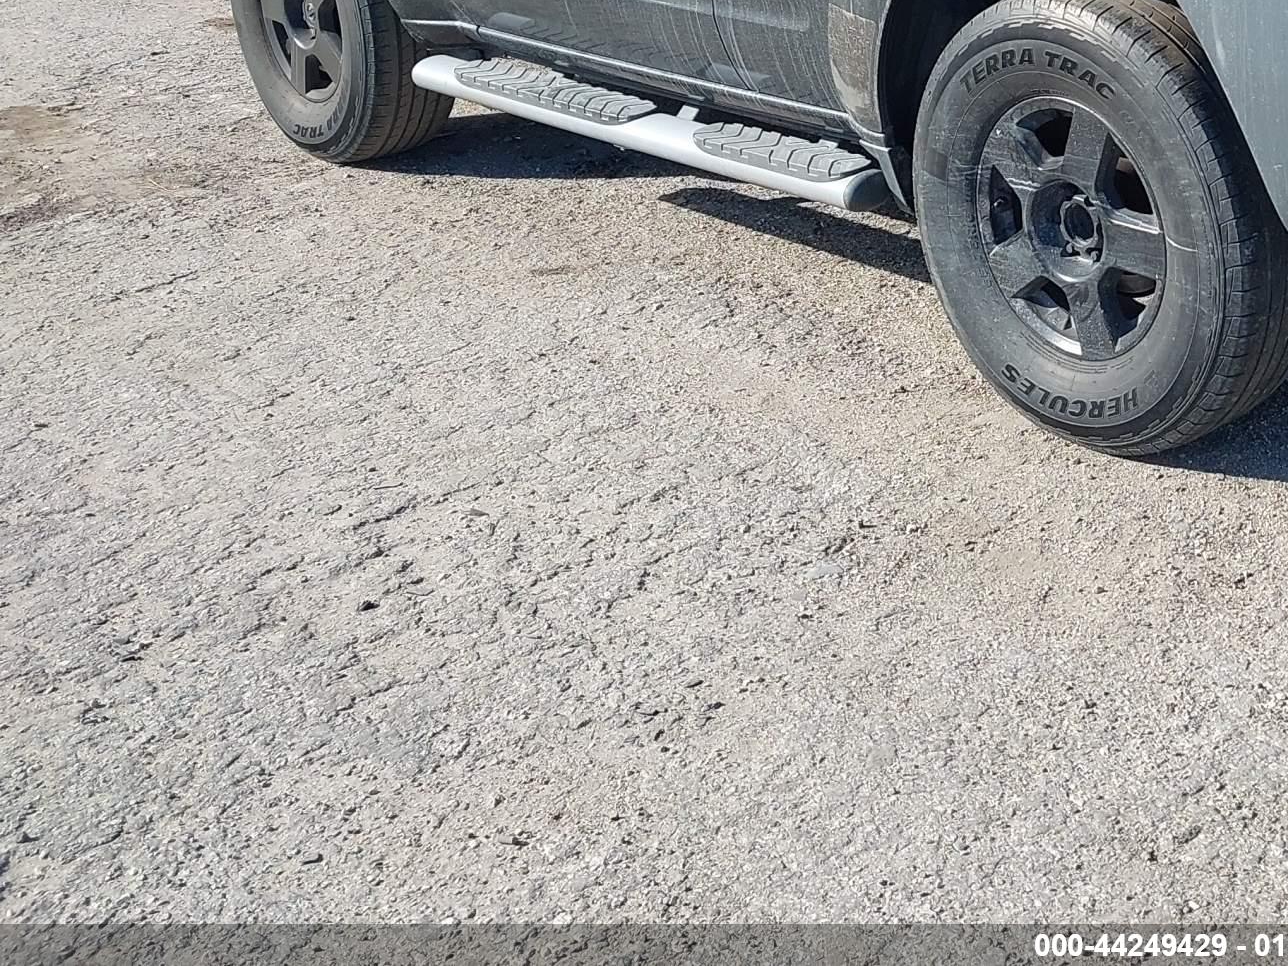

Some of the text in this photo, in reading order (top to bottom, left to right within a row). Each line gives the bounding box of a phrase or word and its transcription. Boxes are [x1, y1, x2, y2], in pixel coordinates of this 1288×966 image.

[959, 48, 1117, 100] TERRA TRAC
[1000, 363, 1140, 419] HERCULES
